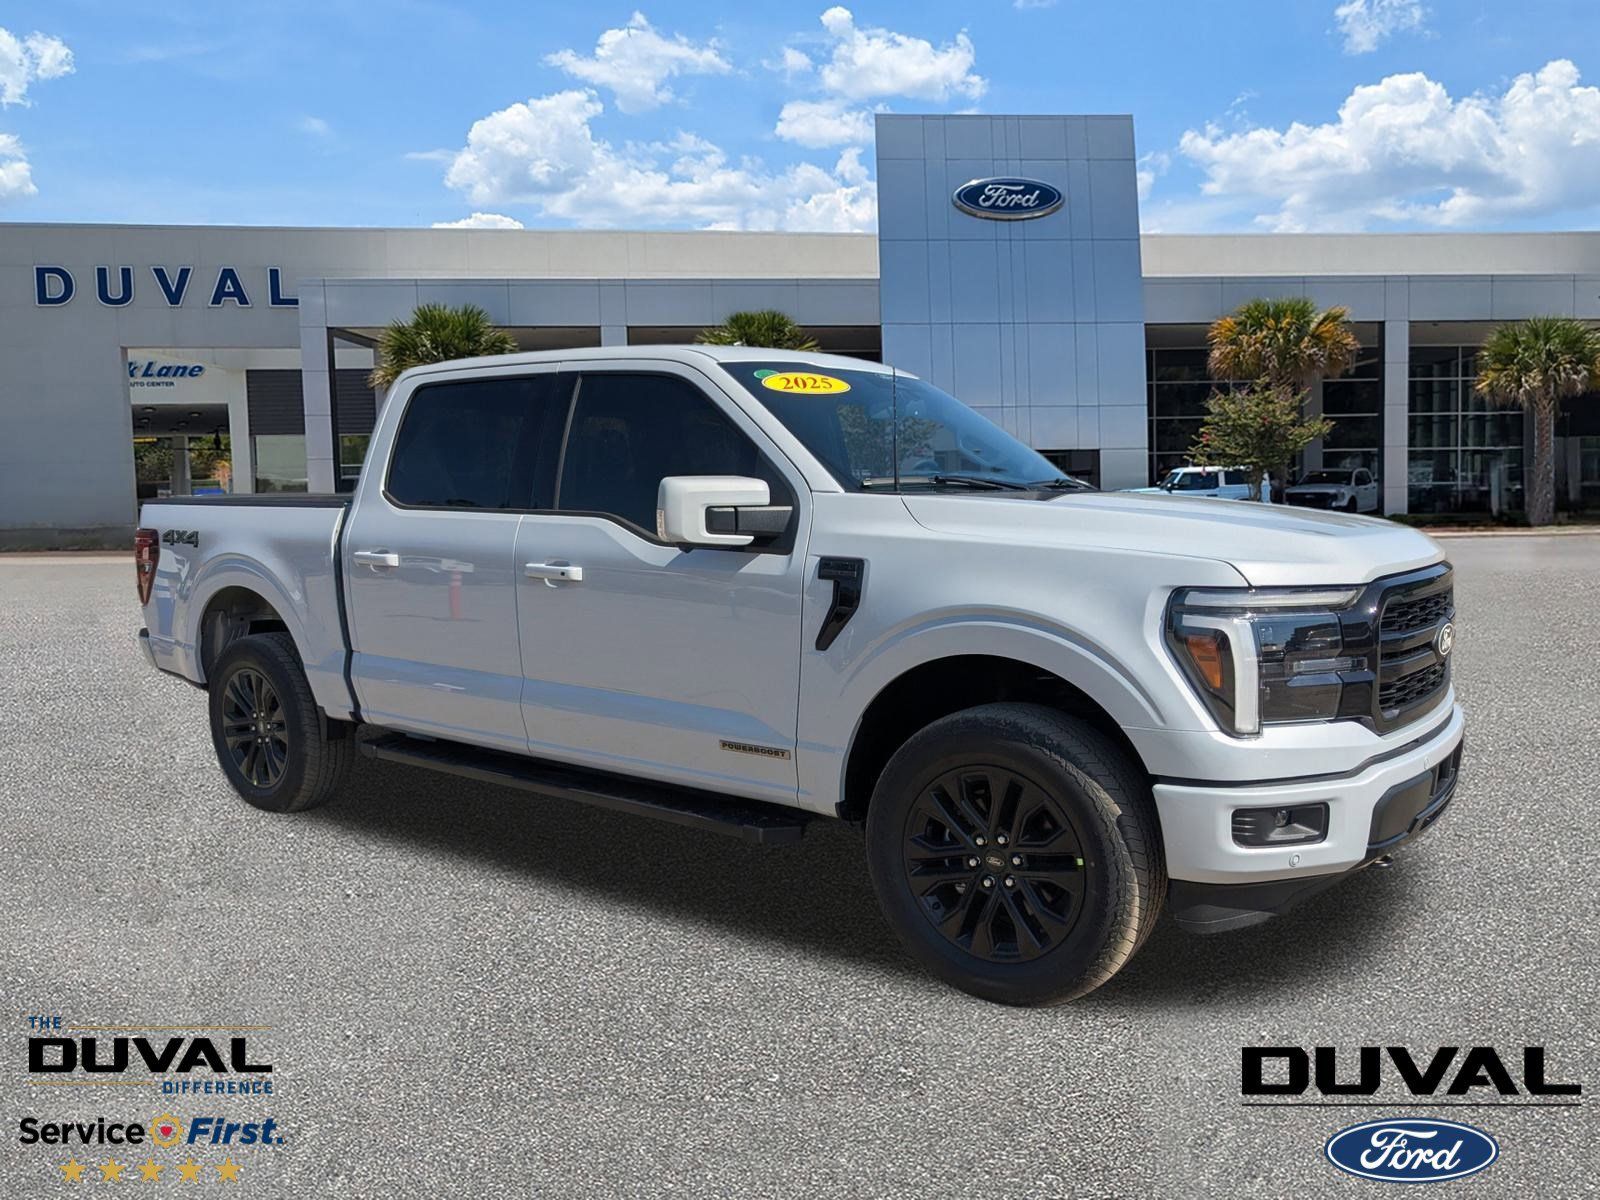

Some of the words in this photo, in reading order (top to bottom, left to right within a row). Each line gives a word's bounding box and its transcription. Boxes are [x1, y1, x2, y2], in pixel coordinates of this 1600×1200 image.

[978, 184, 1040, 207] Ford
[33, 265, 299, 308] DUVAL
[142, 361, 205, 378] Lane
[779, 376, 833, 390] 2025
[721, 741, 787, 758] POWERBOOST
